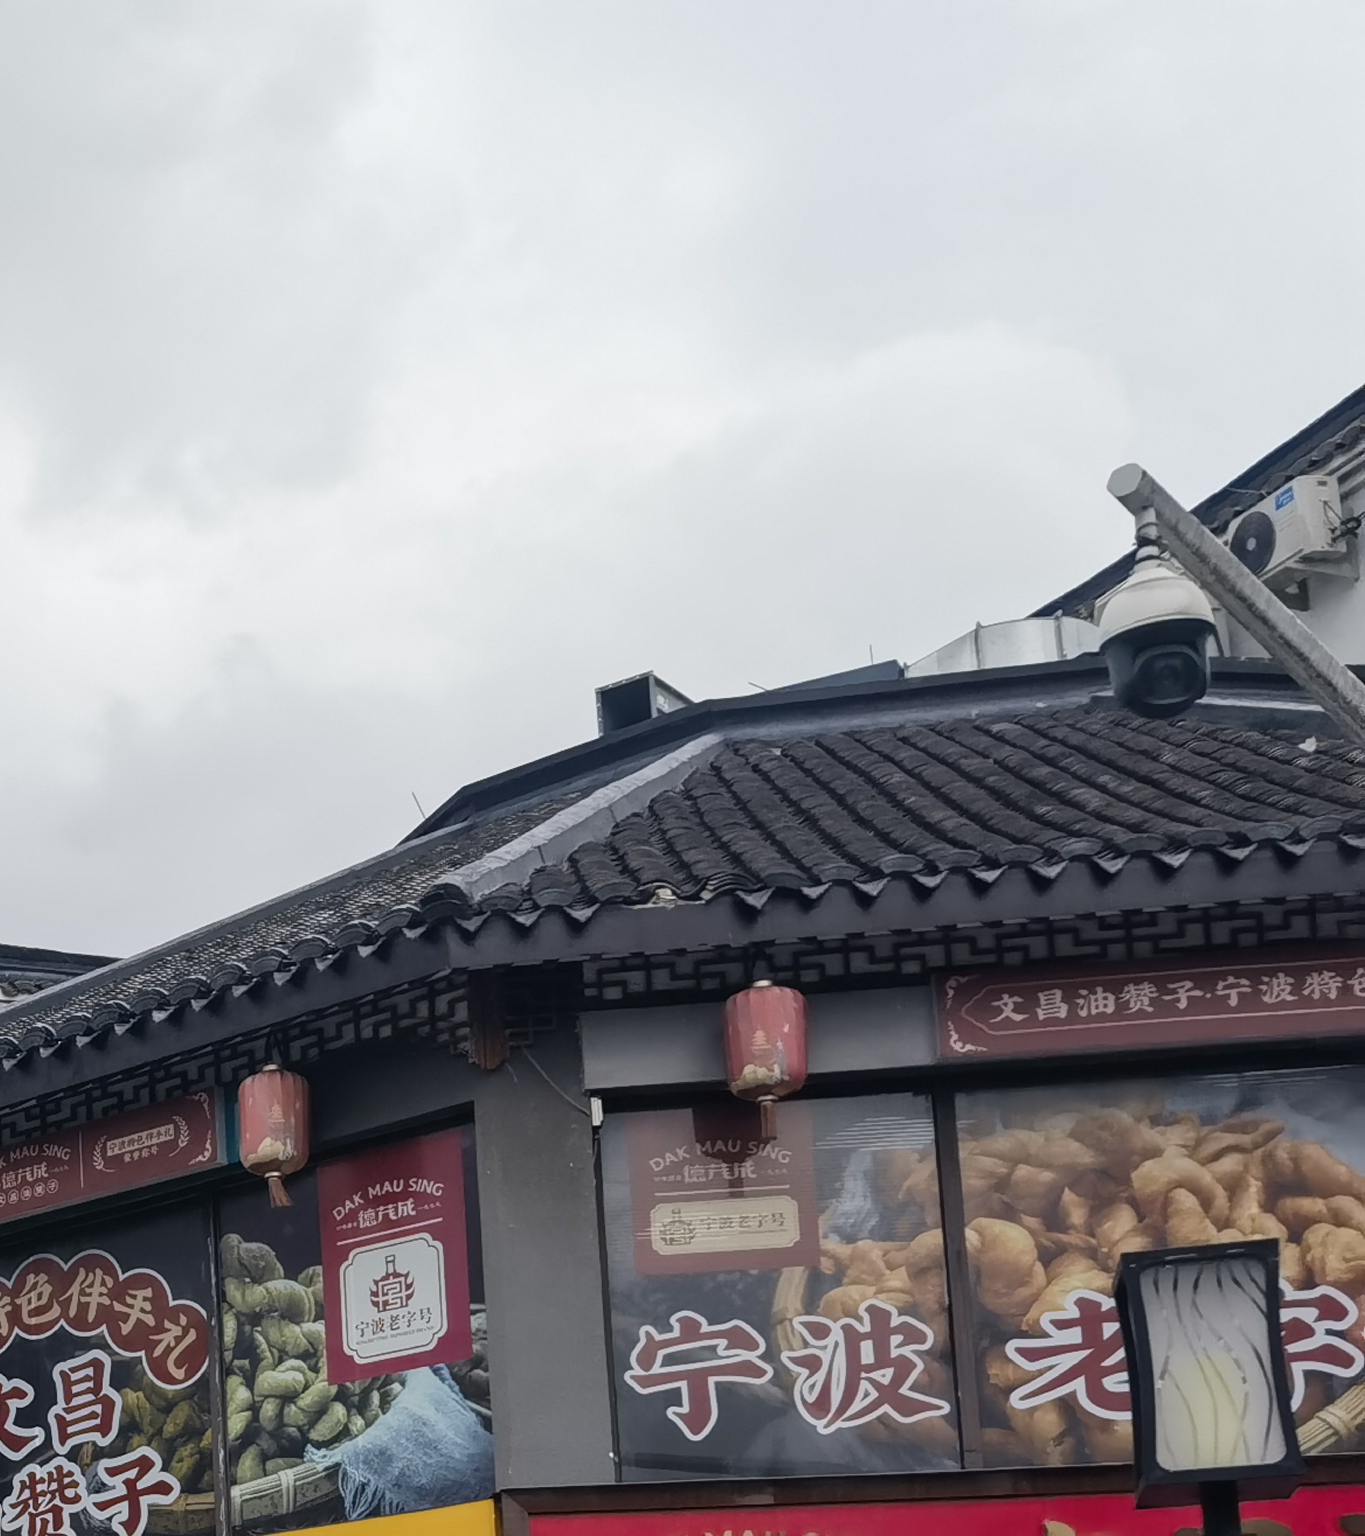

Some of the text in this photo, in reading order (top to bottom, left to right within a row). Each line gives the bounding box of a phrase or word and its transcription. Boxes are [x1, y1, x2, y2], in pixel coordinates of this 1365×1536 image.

[9, 1145, 39, 1164] MAU
[42, 1144, 71, 1160] SING
[649, 1139, 792, 1172] DAK MAU SING
[332, 1177, 444, 1221] DAK MAU SING
[355, 1308, 434, 1338] 宁波老字号
